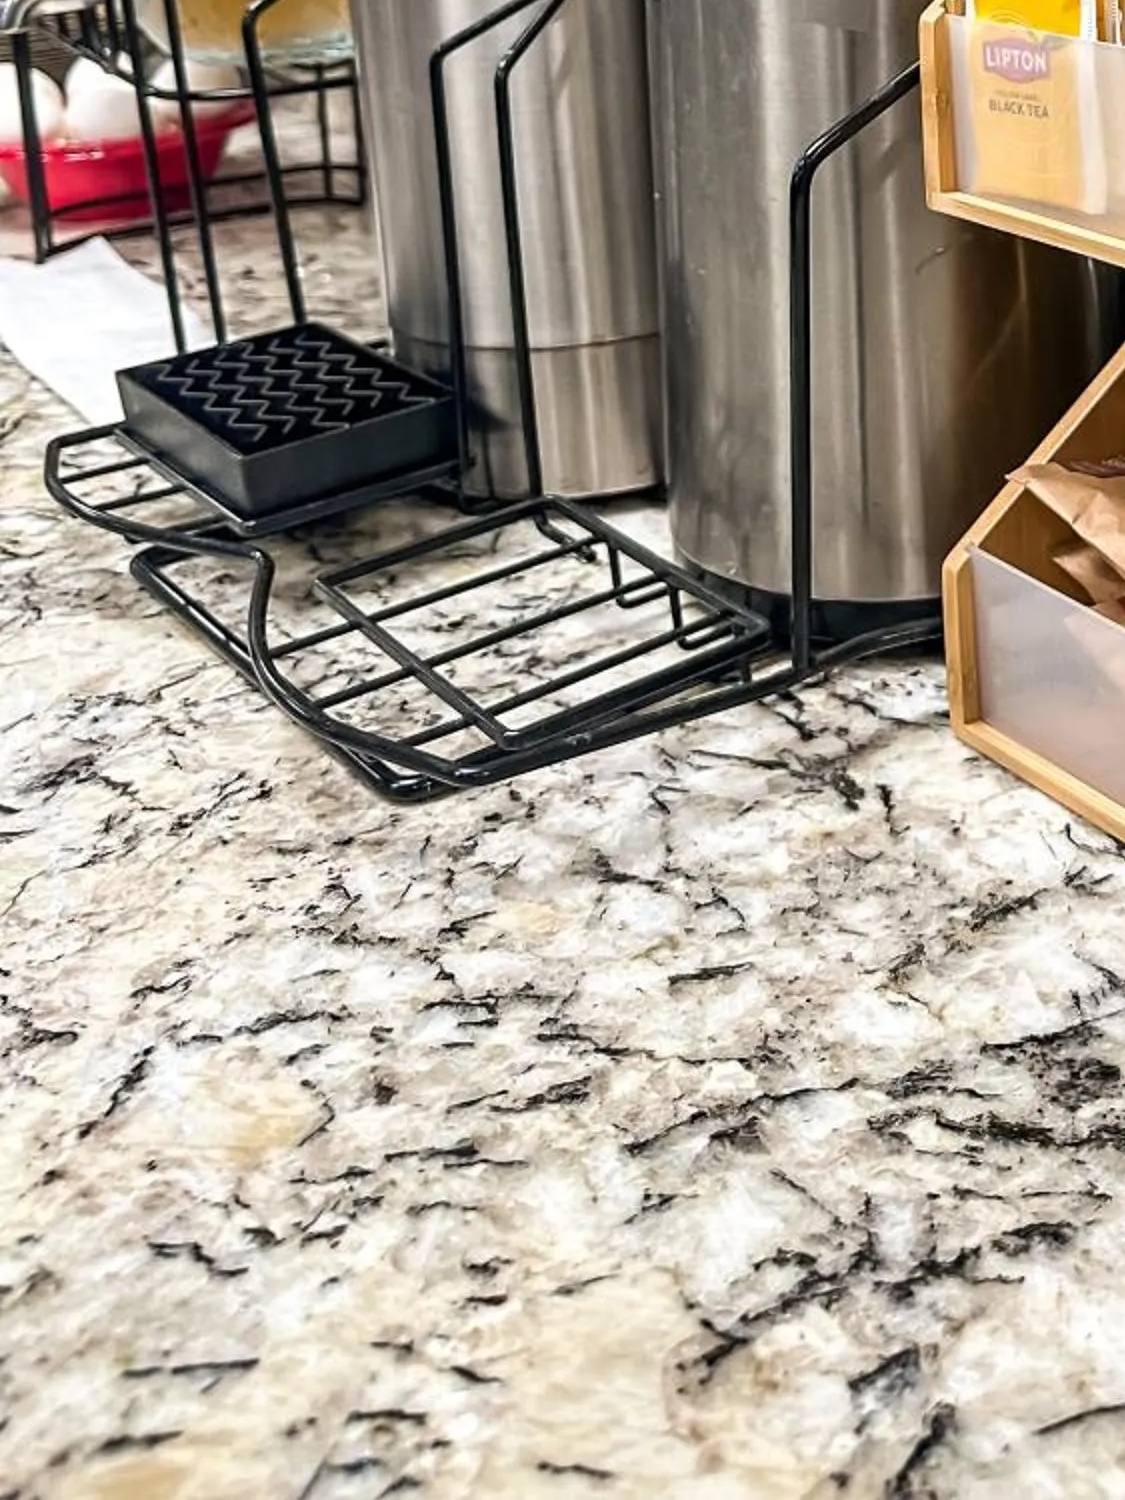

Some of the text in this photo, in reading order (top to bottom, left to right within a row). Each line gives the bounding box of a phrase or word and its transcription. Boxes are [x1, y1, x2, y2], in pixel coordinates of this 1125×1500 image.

[985, 46, 1048, 73] LIPTON
[988, 100, 1049, 118] BLACK TEA
